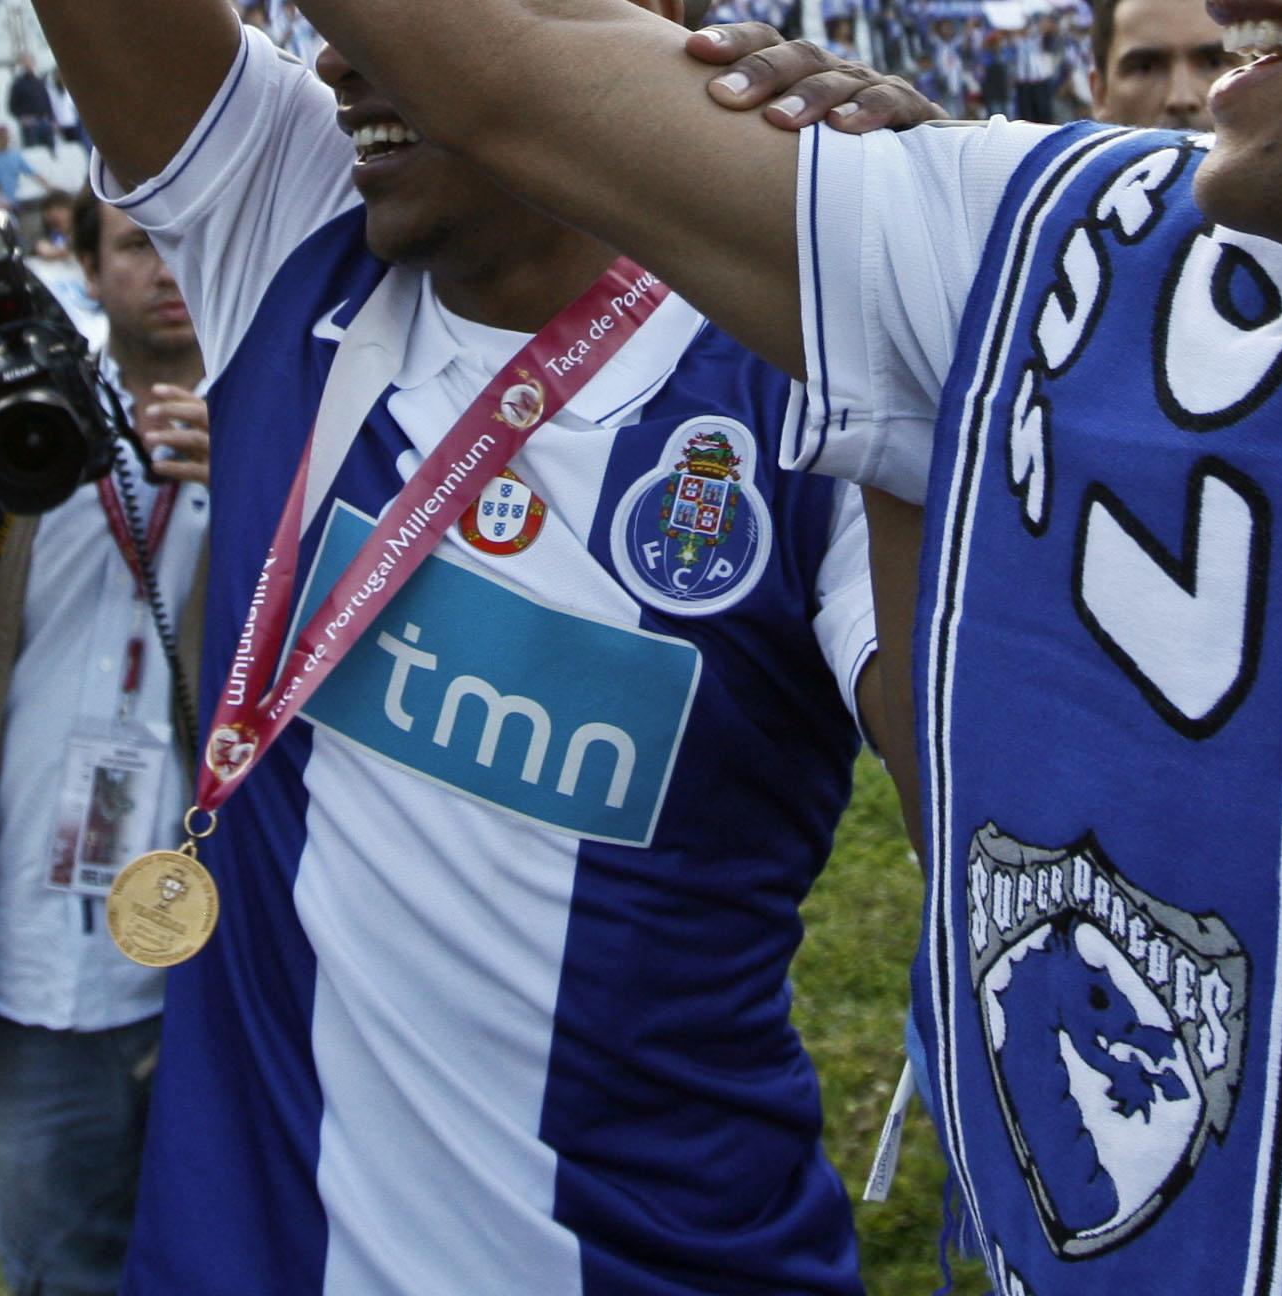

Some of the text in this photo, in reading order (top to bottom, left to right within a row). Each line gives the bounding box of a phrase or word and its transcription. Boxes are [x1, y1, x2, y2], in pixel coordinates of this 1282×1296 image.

[545, 339, 591, 377] Taça
[589, 314, 614, 340] de
[325, 552, 396, 641] Portugal
[385, 434, 496, 557] Millennium
[376, 622, 637, 809] tmn
[970, 854, 1064, 956] SUPER
